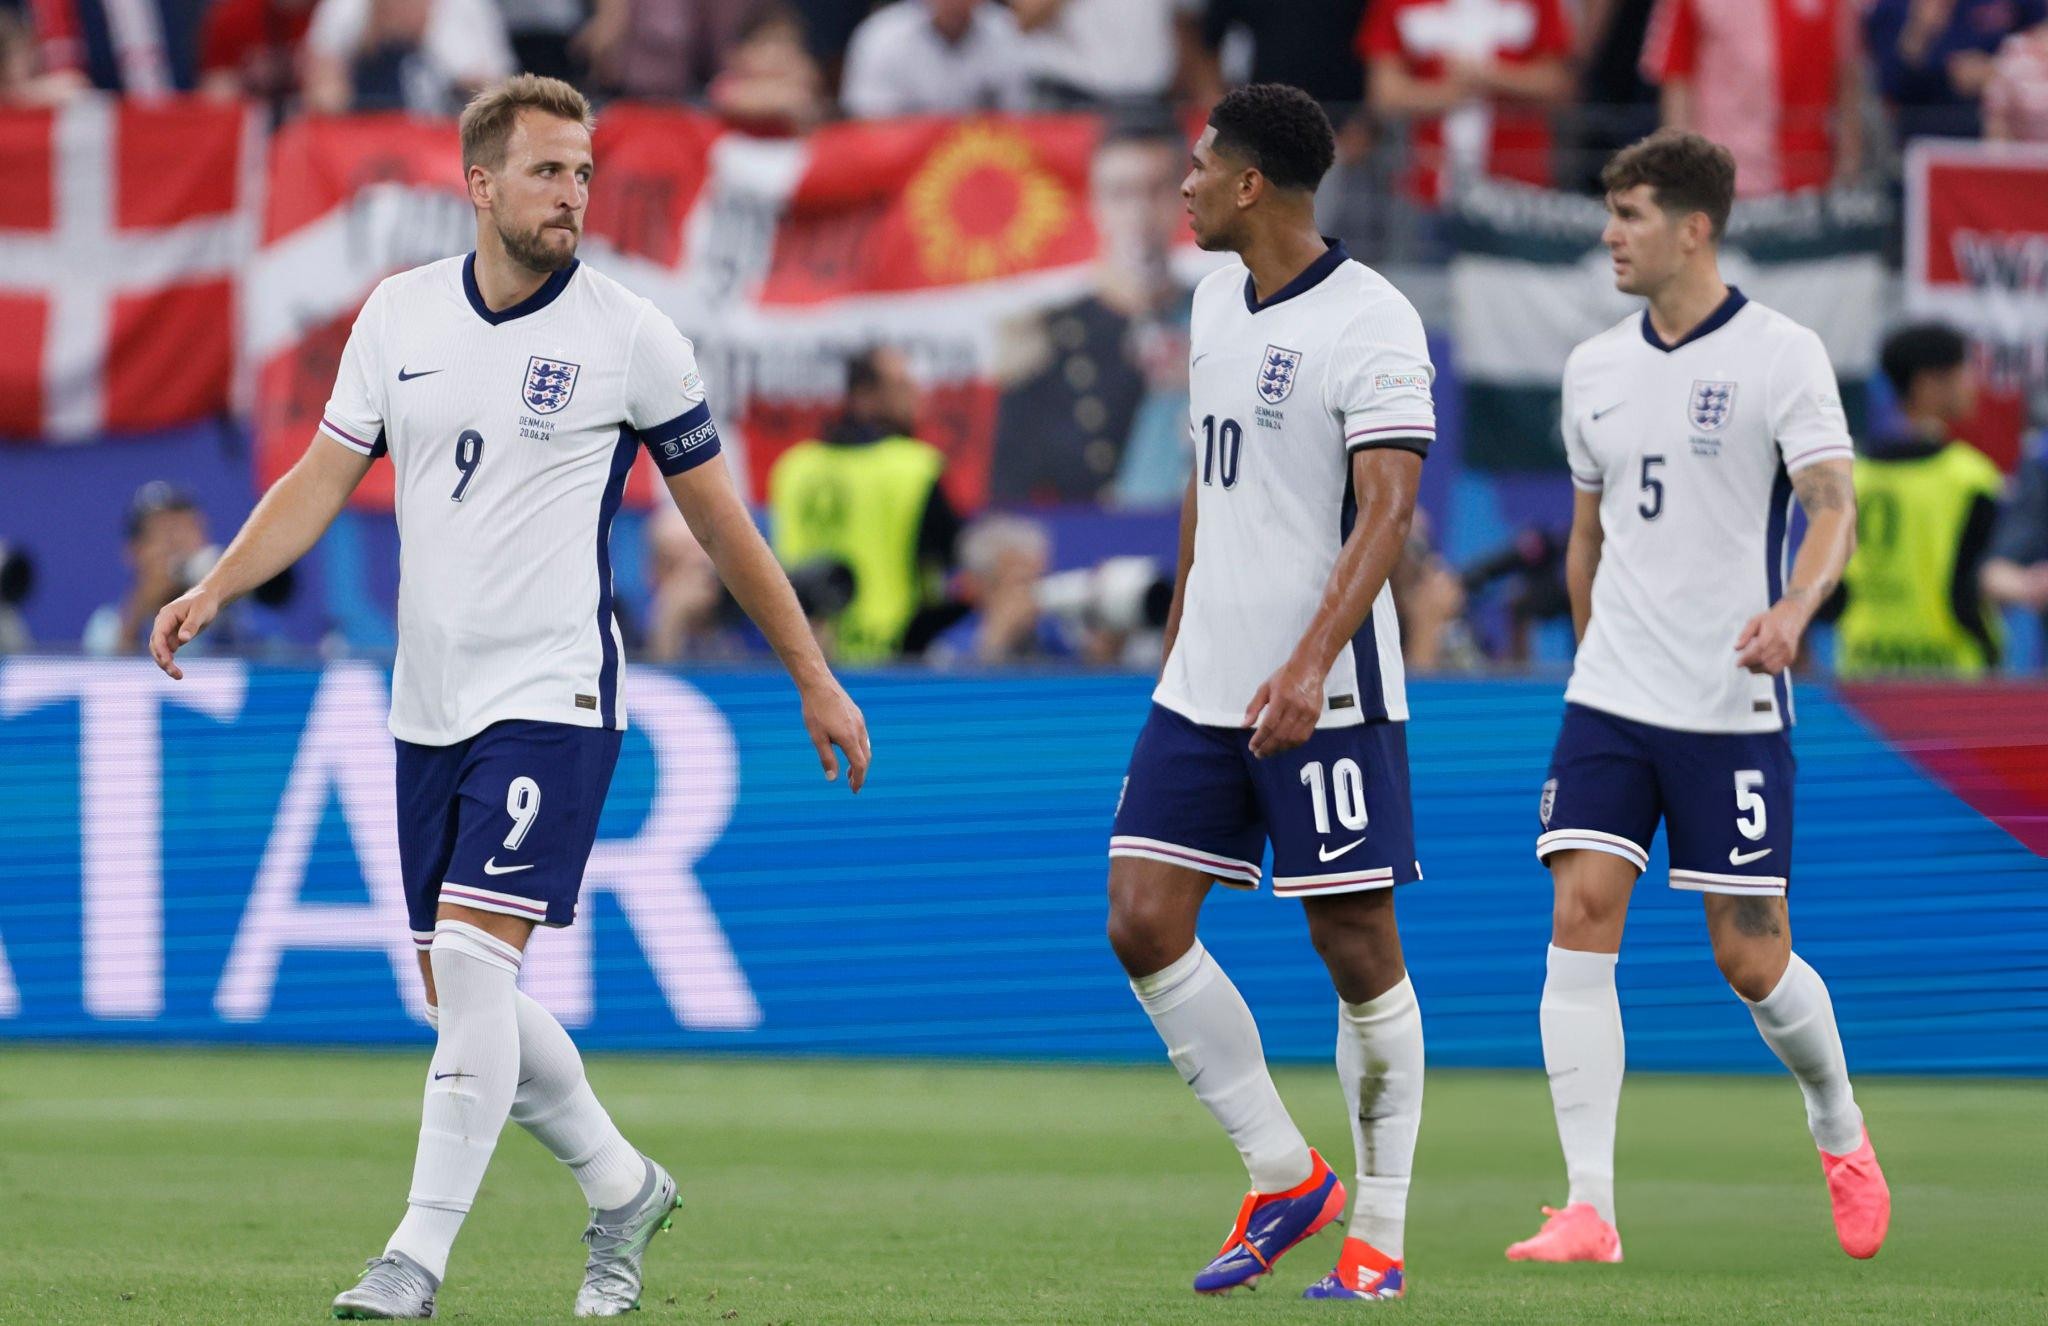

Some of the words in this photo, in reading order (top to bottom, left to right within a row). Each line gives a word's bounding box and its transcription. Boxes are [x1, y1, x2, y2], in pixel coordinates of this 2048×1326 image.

[519, 416, 556, 431] DENMARK
[520, 428, 550, 441] 20.06.24
[1254, 406, 1284, 420] DENMARK
[1256, 417, 1282, 430] 20.06.24
[451, 429, 484, 503] 9
[1202, 414, 1243, 491] 10
[1638, 455, 1666, 521] 5
[502, 776, 541, 851] 9
[1300, 757, 1368, 833] 10
[1734, 769, 1767, 841] 5
[0, 656, 764, 1031] TAR
